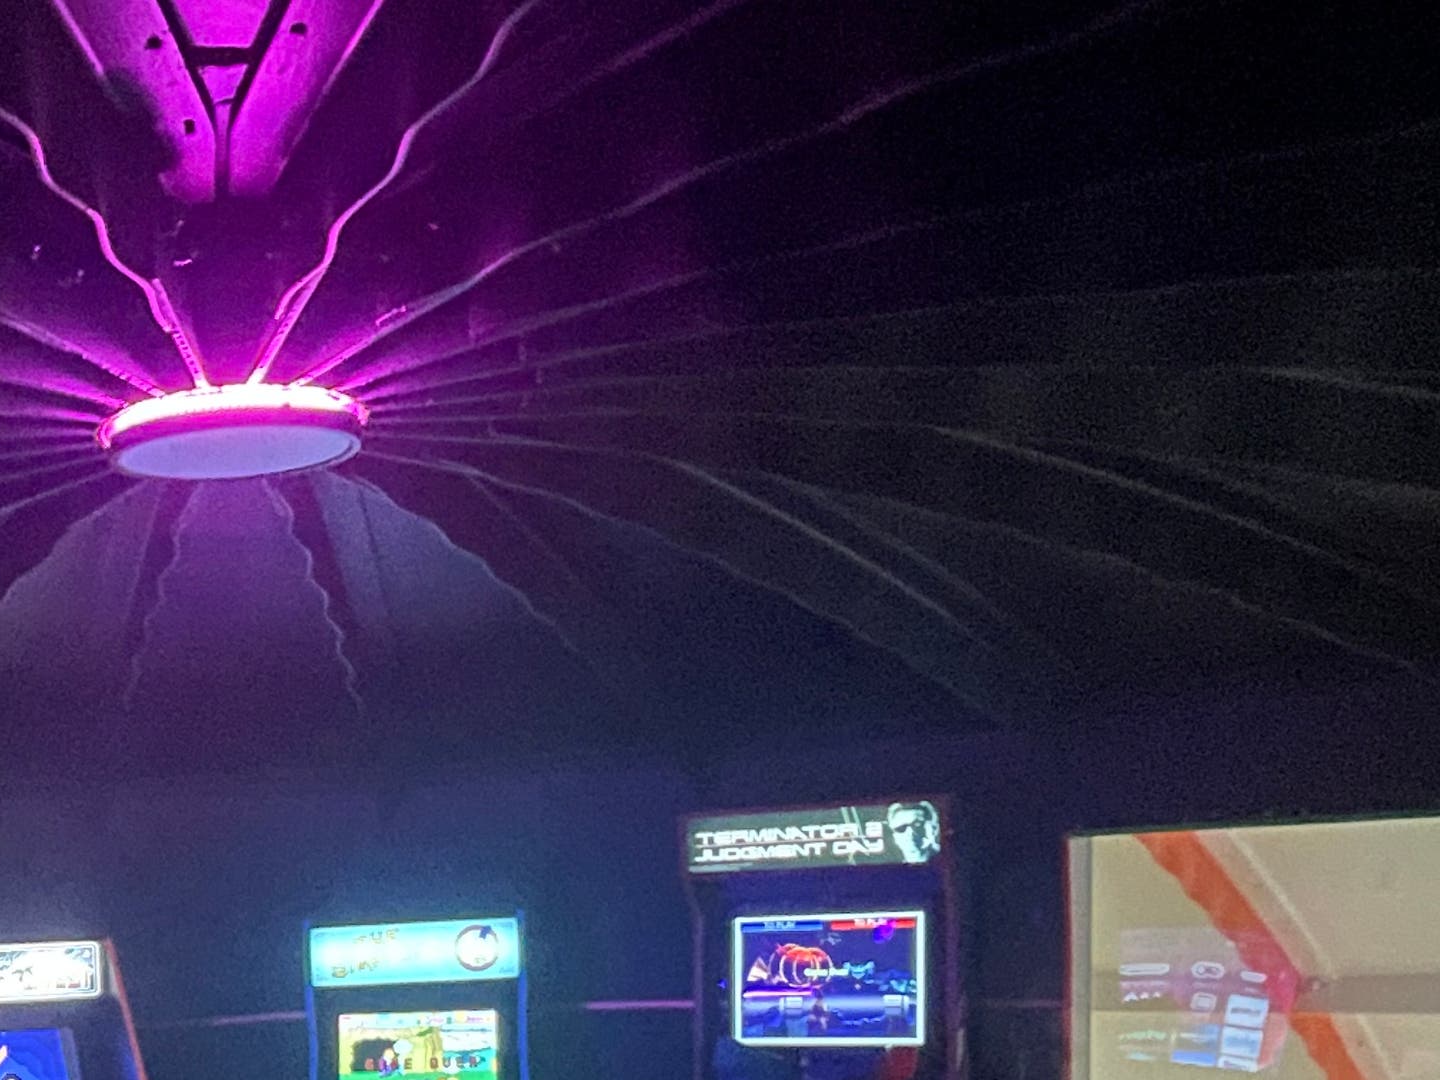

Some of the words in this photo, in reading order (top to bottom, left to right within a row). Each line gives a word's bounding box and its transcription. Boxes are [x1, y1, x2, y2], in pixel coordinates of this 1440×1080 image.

[694, 823, 859, 847] TERMINATOR
[865, 821, 884, 838] 2
[694, 842, 826, 862] JUDGMENT
[832, 839, 885, 856] DAY
